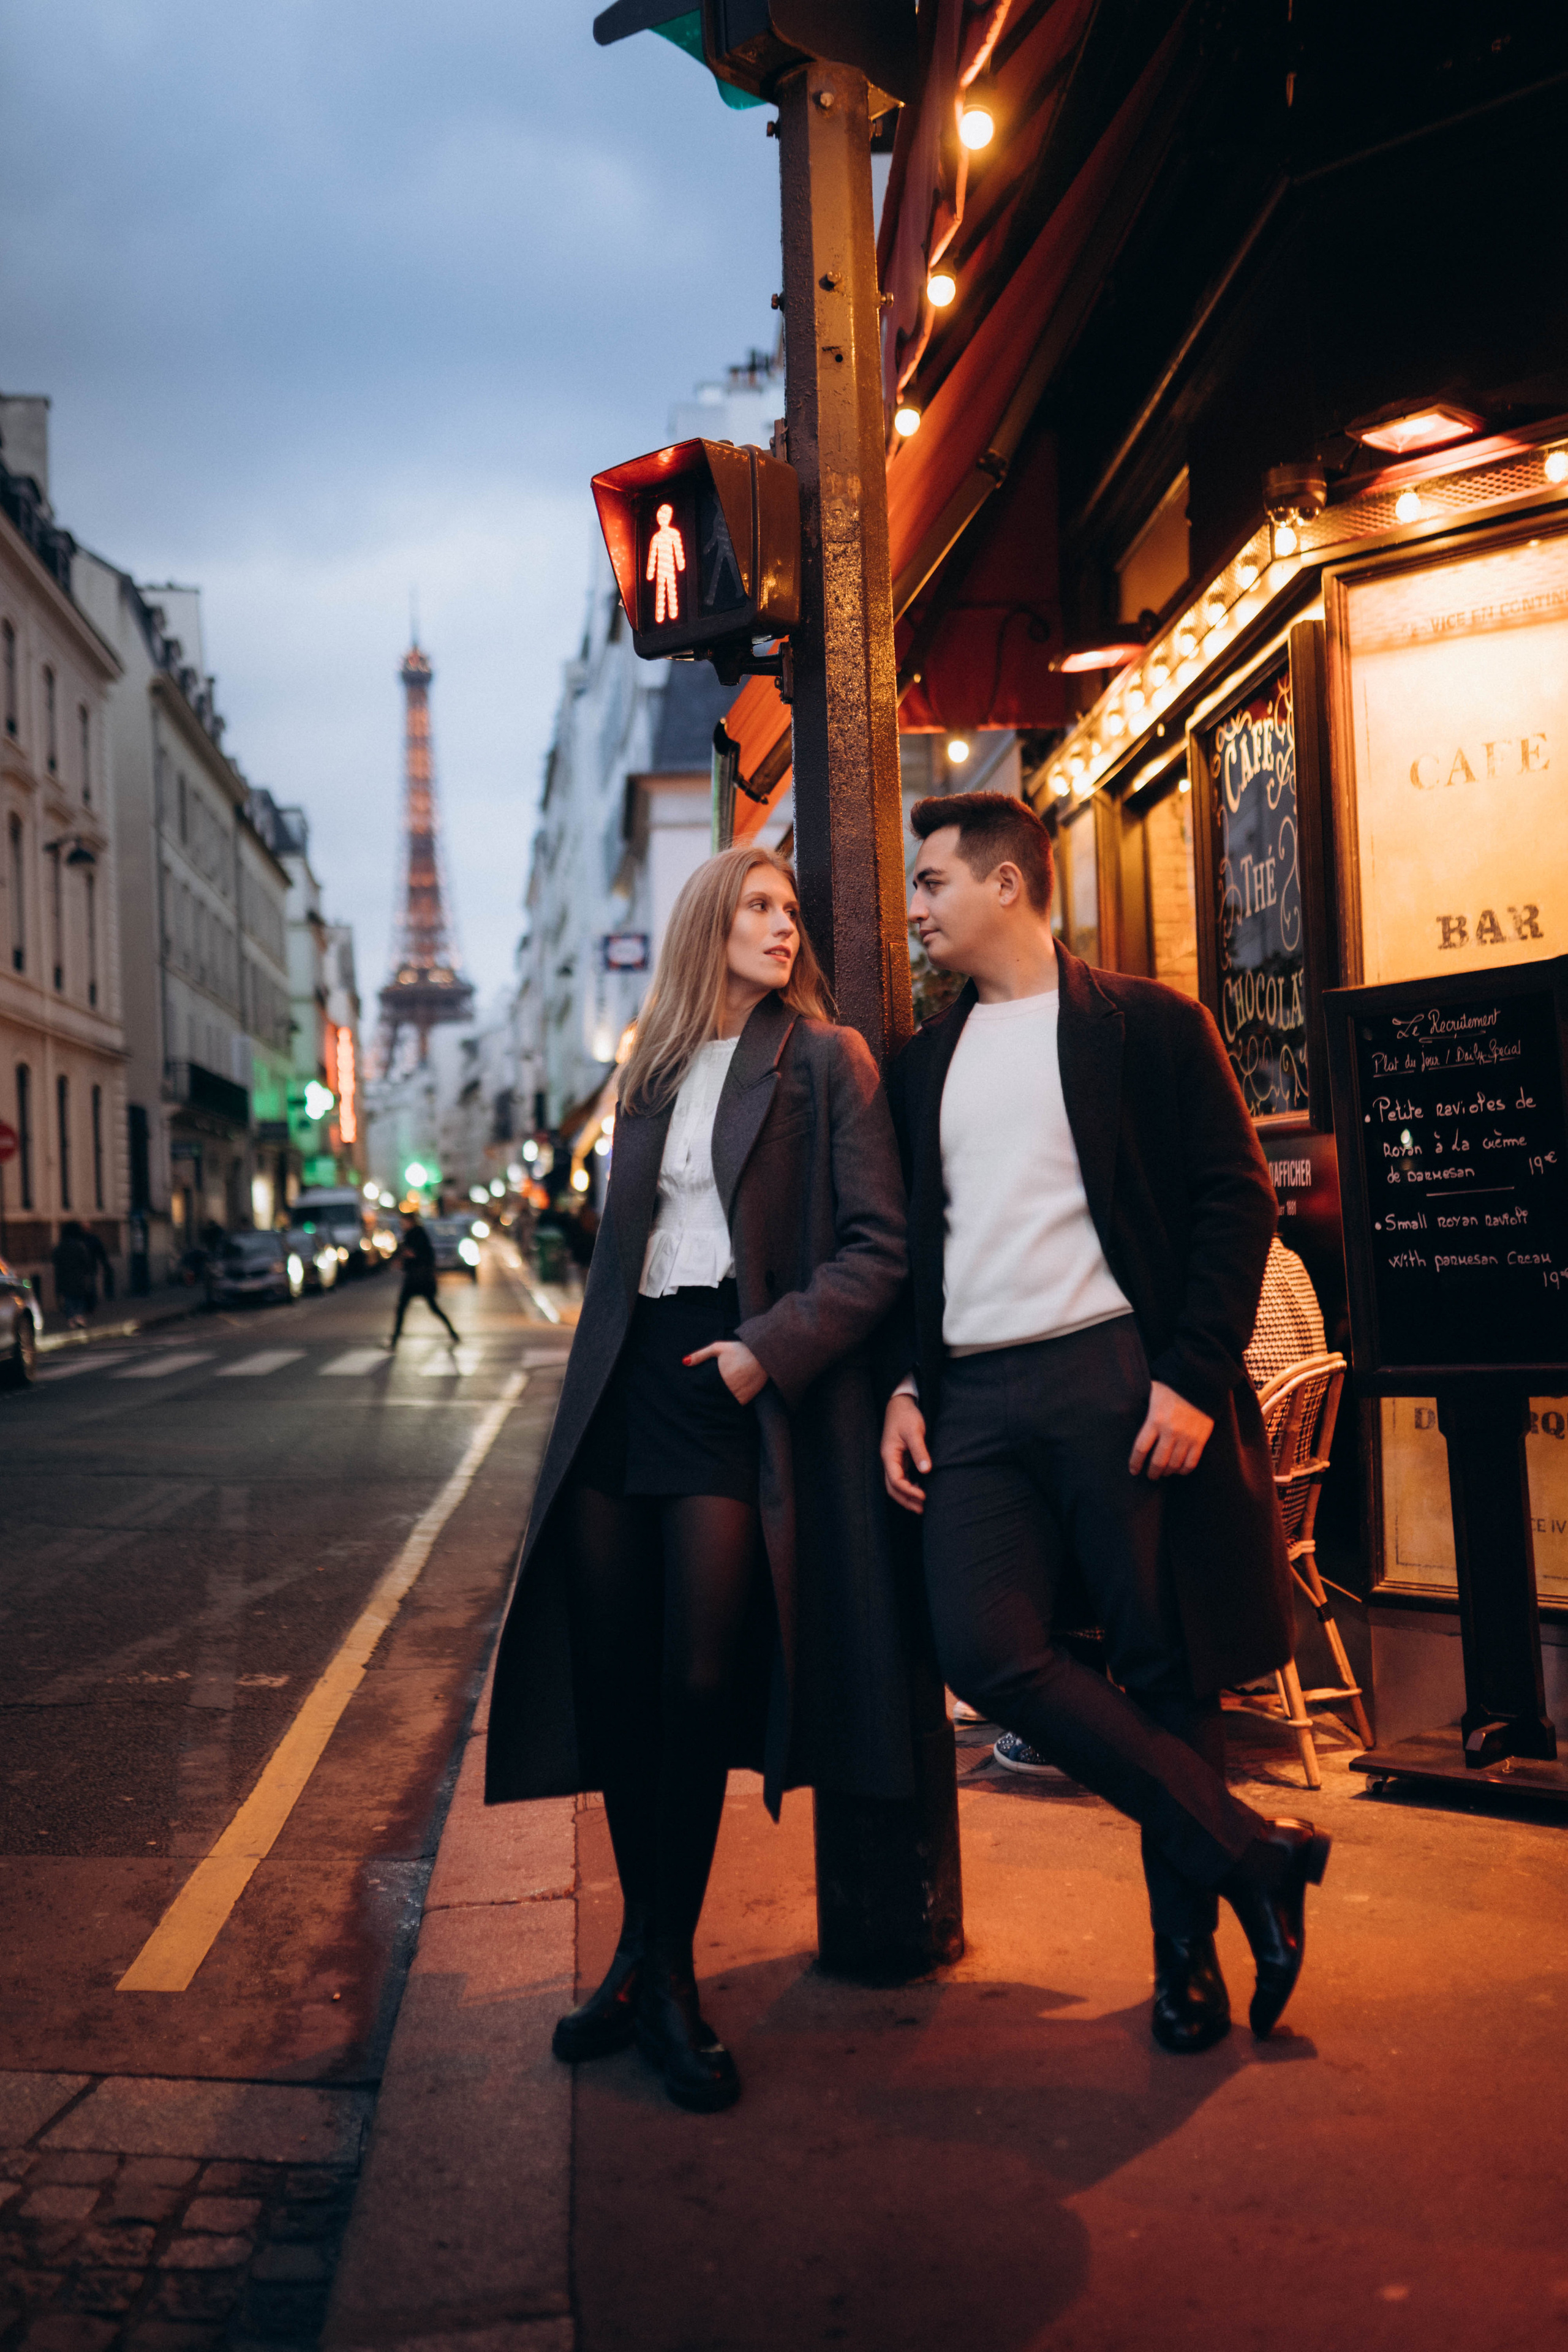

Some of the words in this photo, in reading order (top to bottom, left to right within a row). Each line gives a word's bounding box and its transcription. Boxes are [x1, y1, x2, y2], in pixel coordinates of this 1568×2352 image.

[1224, 699, 1275, 813] CAFÉ
[1436, 904, 1544, 950] BAR
[1392, 1014, 1425, 1039] Le
[1372, 1052, 1399, 1074] Plat
[1405, 1054, 1416, 1068] du
[1456, 1042, 1485, 1066] Daily
[1373, 1096, 1423, 1122] Petite
[1516, 1087, 1536, 1109] de
[1434, 1131, 1443, 1153] à
[1387, 1166, 1401, 1183] de
[1385, 1212, 1427, 1231] Small
